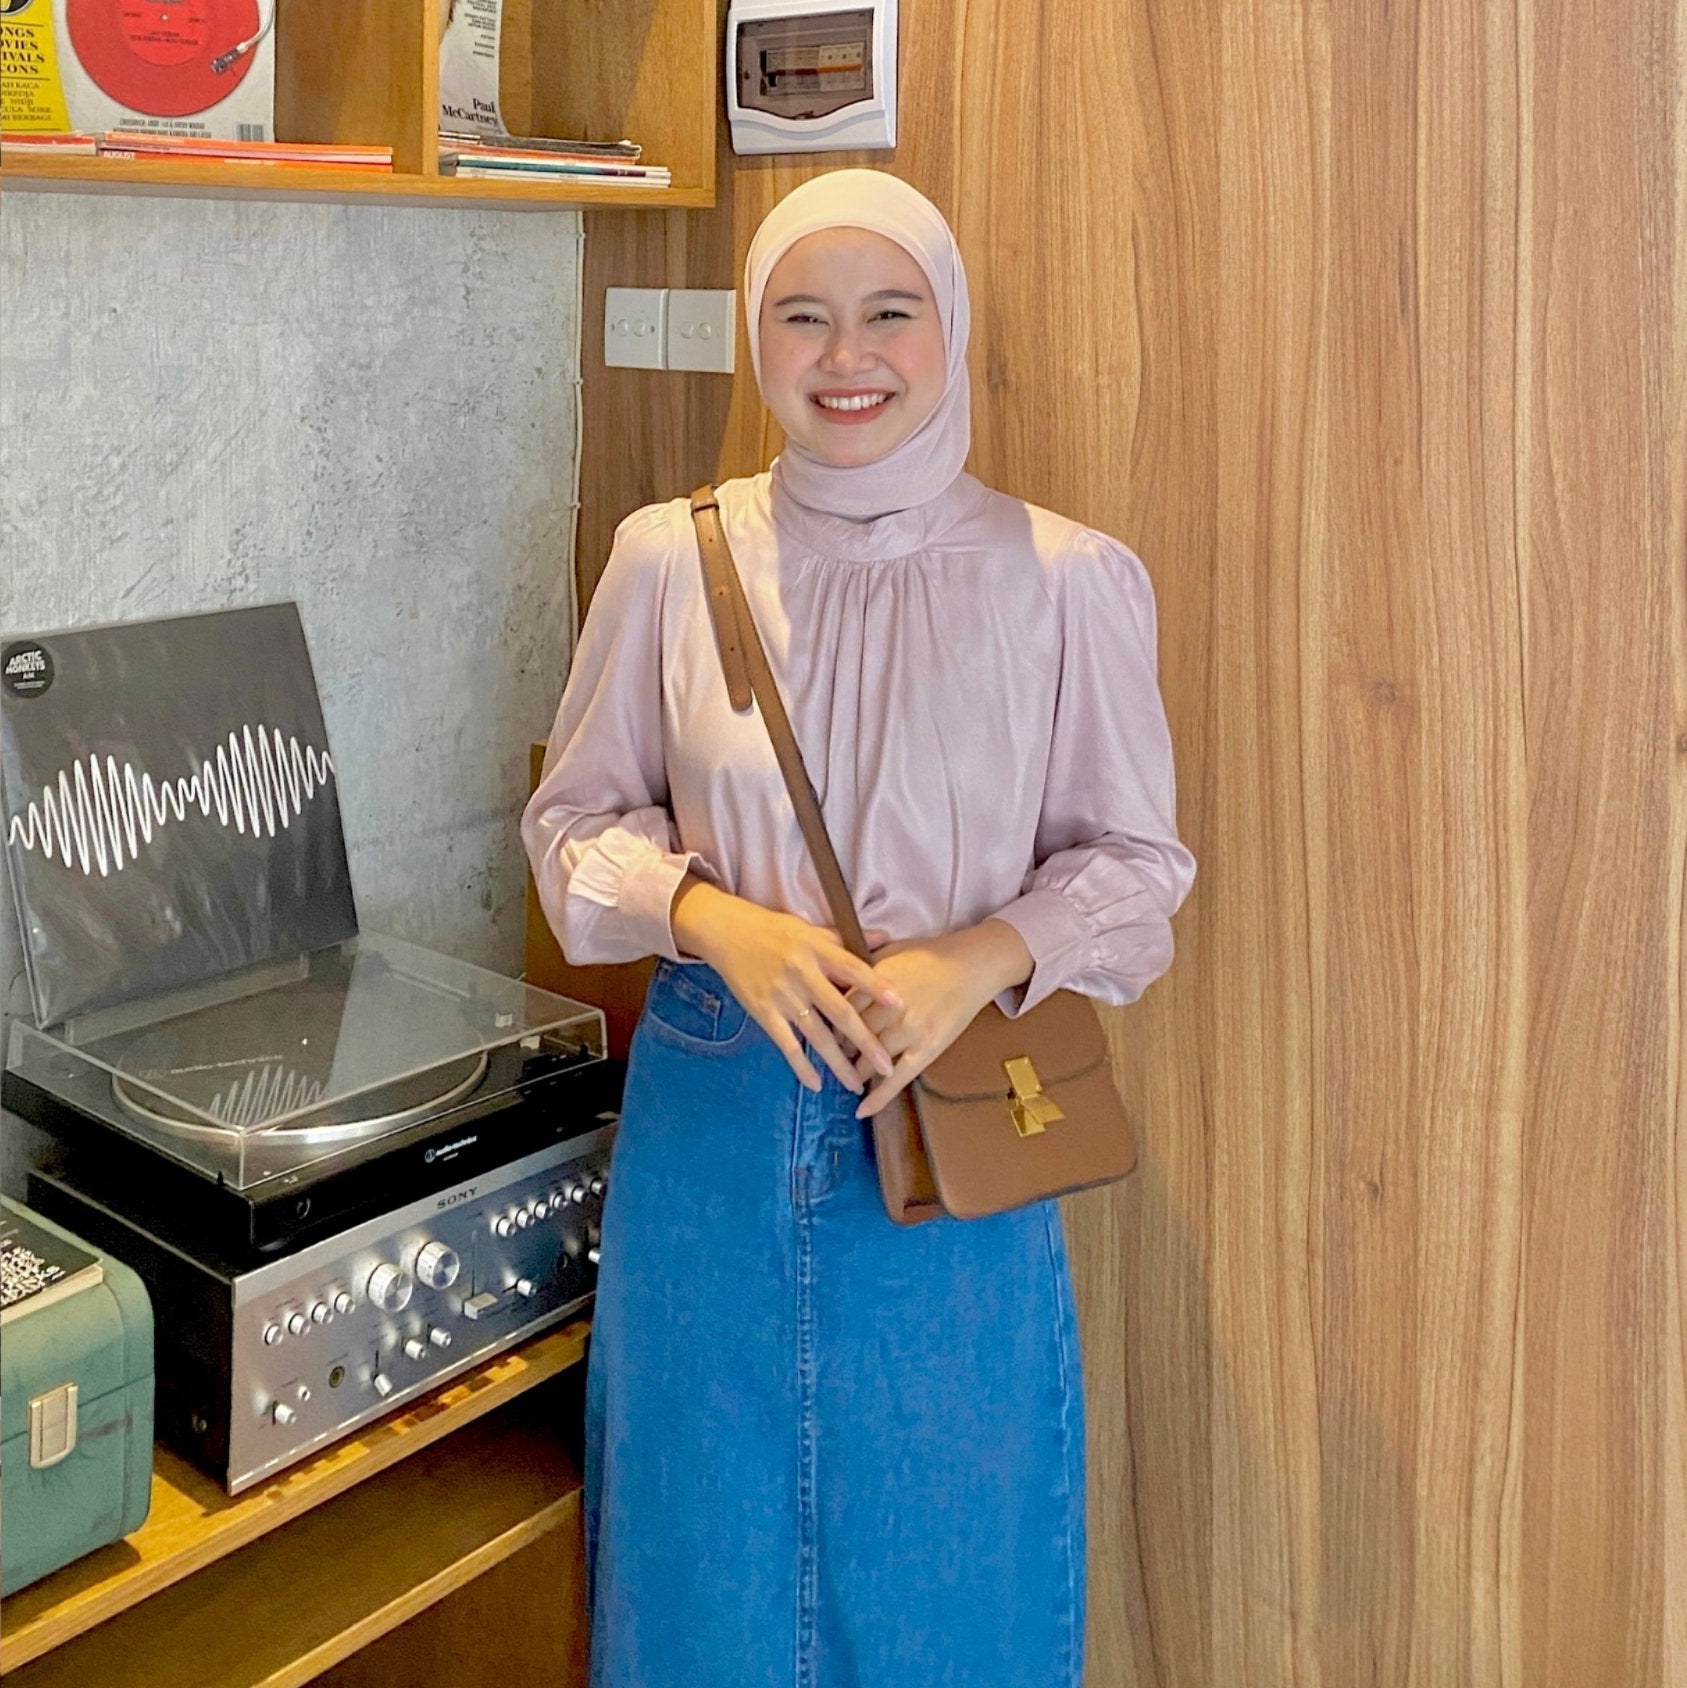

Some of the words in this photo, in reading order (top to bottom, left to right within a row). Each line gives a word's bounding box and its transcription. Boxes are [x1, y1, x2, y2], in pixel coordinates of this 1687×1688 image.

[473, 98, 495, 113] Paul
[442, 104, 498, 126] McCartney
[103, 150, 136, 160] AUGUST
[8, 650, 42, 667] ARCTIC
[5, 660, 46, 675] MONKEYS
[437, 1186, 478, 1210] SONY
